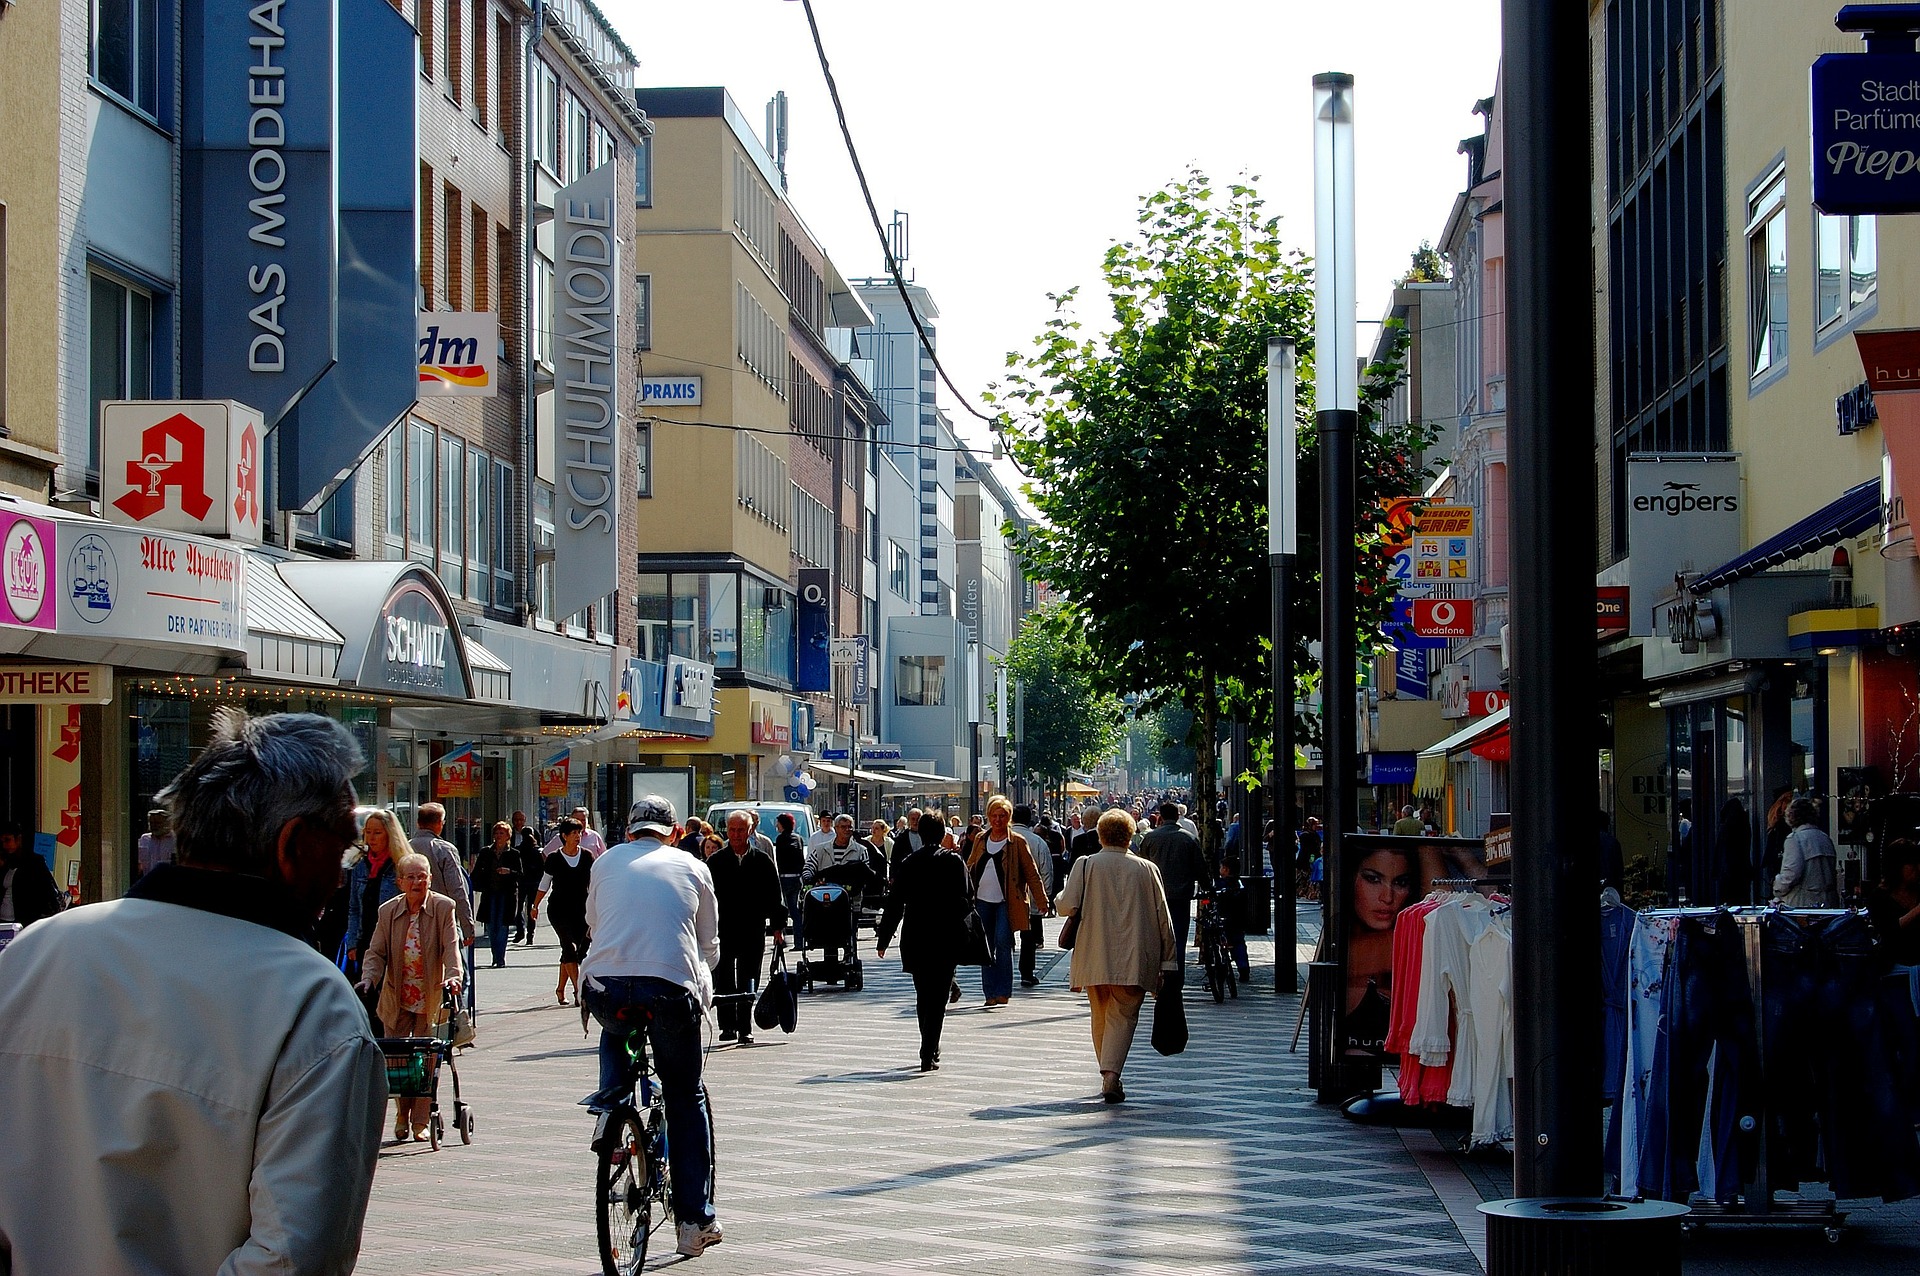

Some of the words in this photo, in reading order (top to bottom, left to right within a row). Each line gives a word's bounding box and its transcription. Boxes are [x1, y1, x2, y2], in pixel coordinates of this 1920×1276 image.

[1826, 141, 1920, 181] Piep
[249, 263, 286, 372] DAS
[419, 325, 478, 365] dm
[565, 197, 612, 534] SCHUHMODE
[1875, 366, 1920, 380] hu
[644, 383, 696, 399] PRAXIS
[1422, 509, 1471, 518] EISEBÜRO
[1633, 490, 1738, 517] engbers
[1418, 519, 1471, 532] GRAF
[1421, 544, 1438, 553] ITS
[141, 536, 177, 573] Alte
[186, 543, 233, 589] Apotheke
[1596, 601, 1621, 613] One
[168, 615, 186, 634] DER
[189, 617, 219, 637] PARTNER
[1421, 626, 1465, 635] vodafone
[386, 615, 446, 668] SCHMITZ
[0, 671, 90, 694] THEKE
[862, 749, 902, 759] NOKIA
